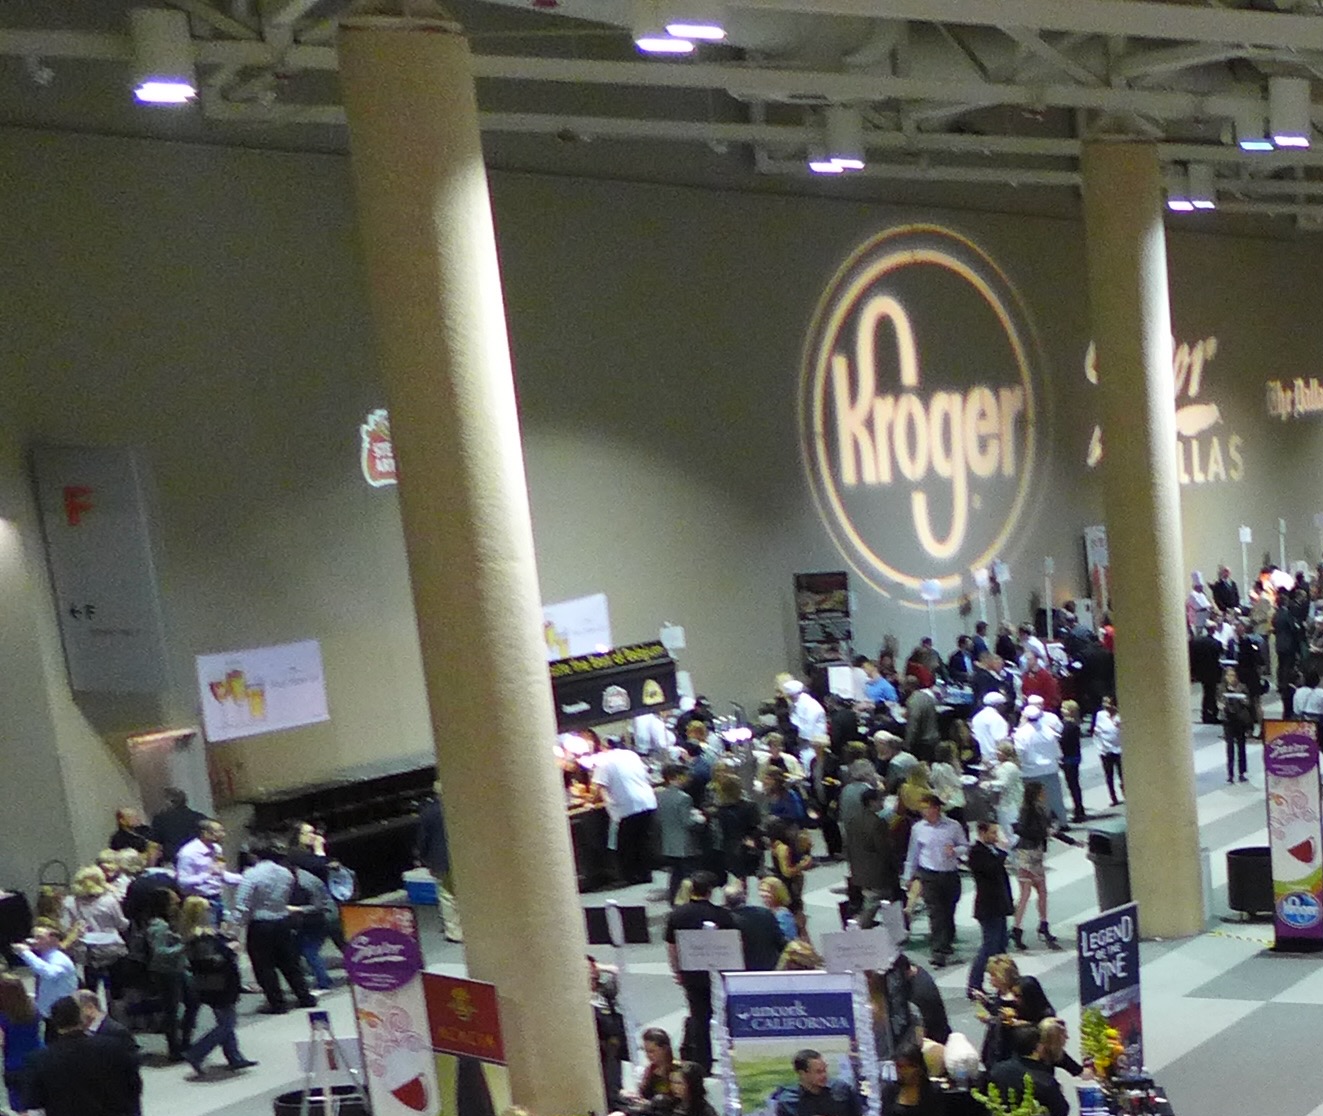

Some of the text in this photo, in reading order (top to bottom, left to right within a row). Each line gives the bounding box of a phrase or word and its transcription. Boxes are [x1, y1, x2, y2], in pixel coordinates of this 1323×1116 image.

[831, 295, 1024, 559] Kroger
[1081, 915, 1133, 957] LEGEND
[1090, 951, 1128, 992] VINE
[750, 1014, 850, 1031] CALIFORNIA
